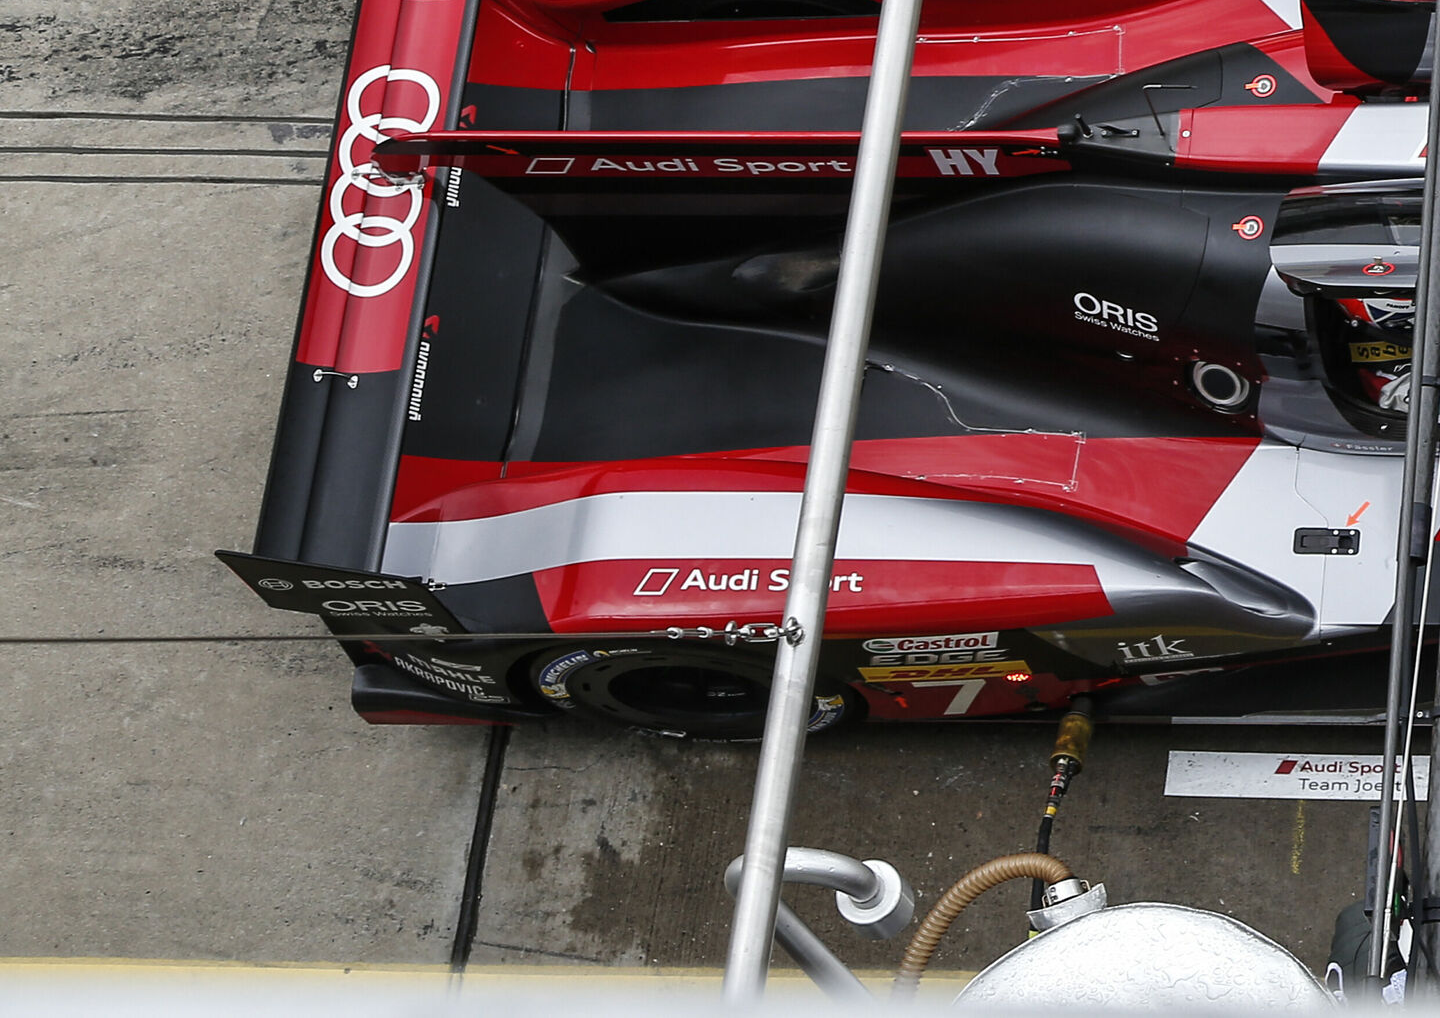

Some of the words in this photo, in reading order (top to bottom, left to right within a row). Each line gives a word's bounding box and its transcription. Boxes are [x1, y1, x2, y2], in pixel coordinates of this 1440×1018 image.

[590, 158, 700, 172] Audi
[712, 158, 853, 175] Sport
[927, 148, 1001, 175] HY
[1073, 292, 1159, 332] ORIS
[1074, 311, 1108, 328] Swiss
[1109, 321, 1160, 342] Watches
[301, 580, 408, 590] BOSCH
[680, 569, 760, 591] Audi
[767, 569, 864, 592] Srt
[321, 600, 427, 612] ORIS
[896, 635, 991, 652] Castrol
[1116, 633, 1193, 659] itk
[869, 649, 1010, 666] EDGE
[544, 653, 590, 684] MICHELIN
[888, 666, 1001, 679] DHL
[911, 678, 987, 716] 7
[1300, 760, 1343, 773] Audi
[1347, 760, 1402, 776] Spot
[1298, 778, 1349, 791] Team
[1354, 778, 1402, 793] Joet
